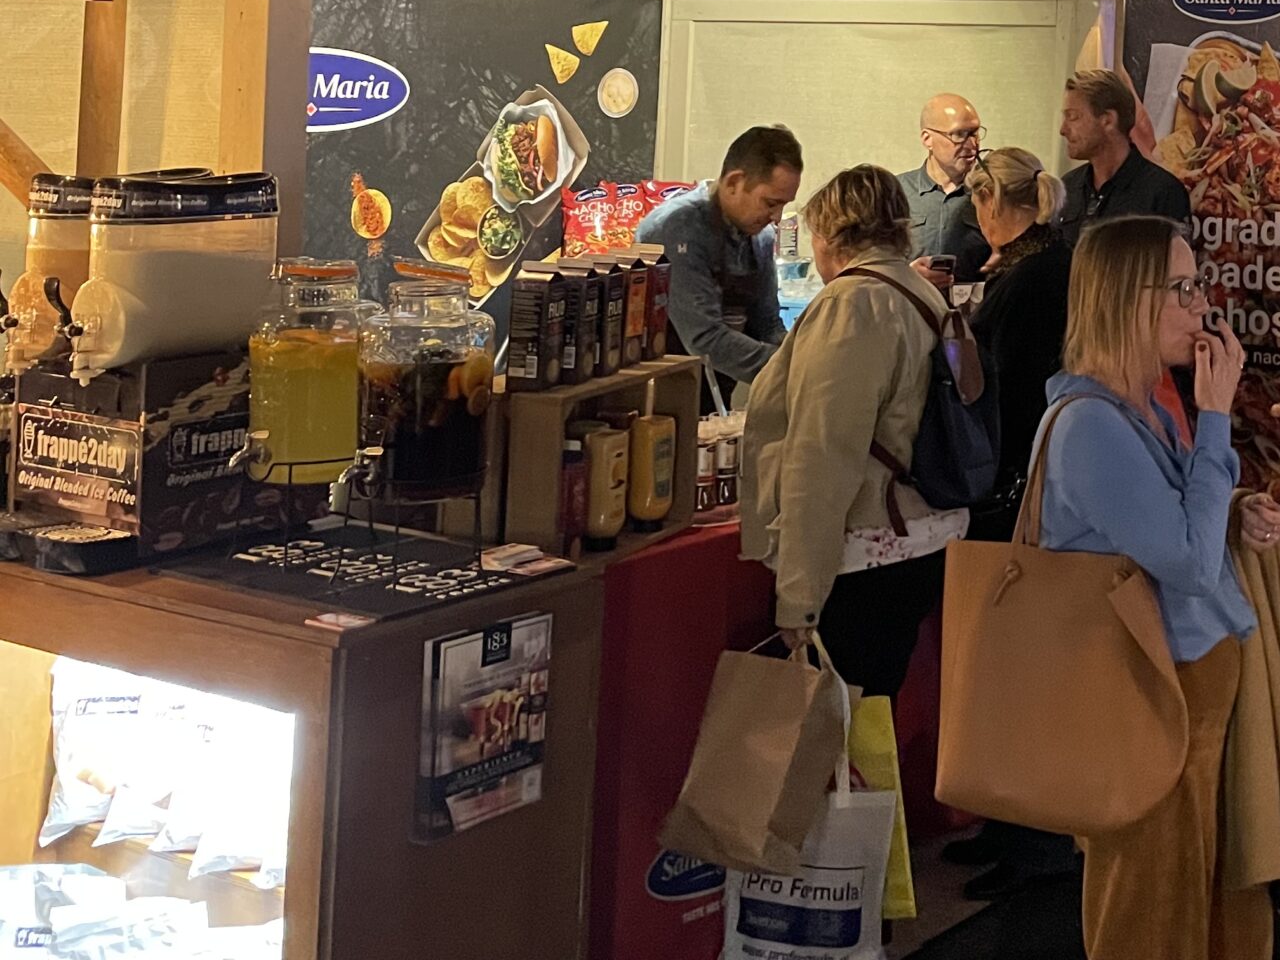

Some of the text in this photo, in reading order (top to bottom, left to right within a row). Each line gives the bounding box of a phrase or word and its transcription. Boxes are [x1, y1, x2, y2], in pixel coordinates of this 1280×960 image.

[313, 73, 390, 100] Maria
[37, 429, 127, 474] frappé2day
[18, 470, 54, 490] Original
[54, 476, 89, 497] Blended
[89, 483, 104, 500] Ice
[106, 487, 136, 506] Coffee
[747, 873, 783, 895] Pro
